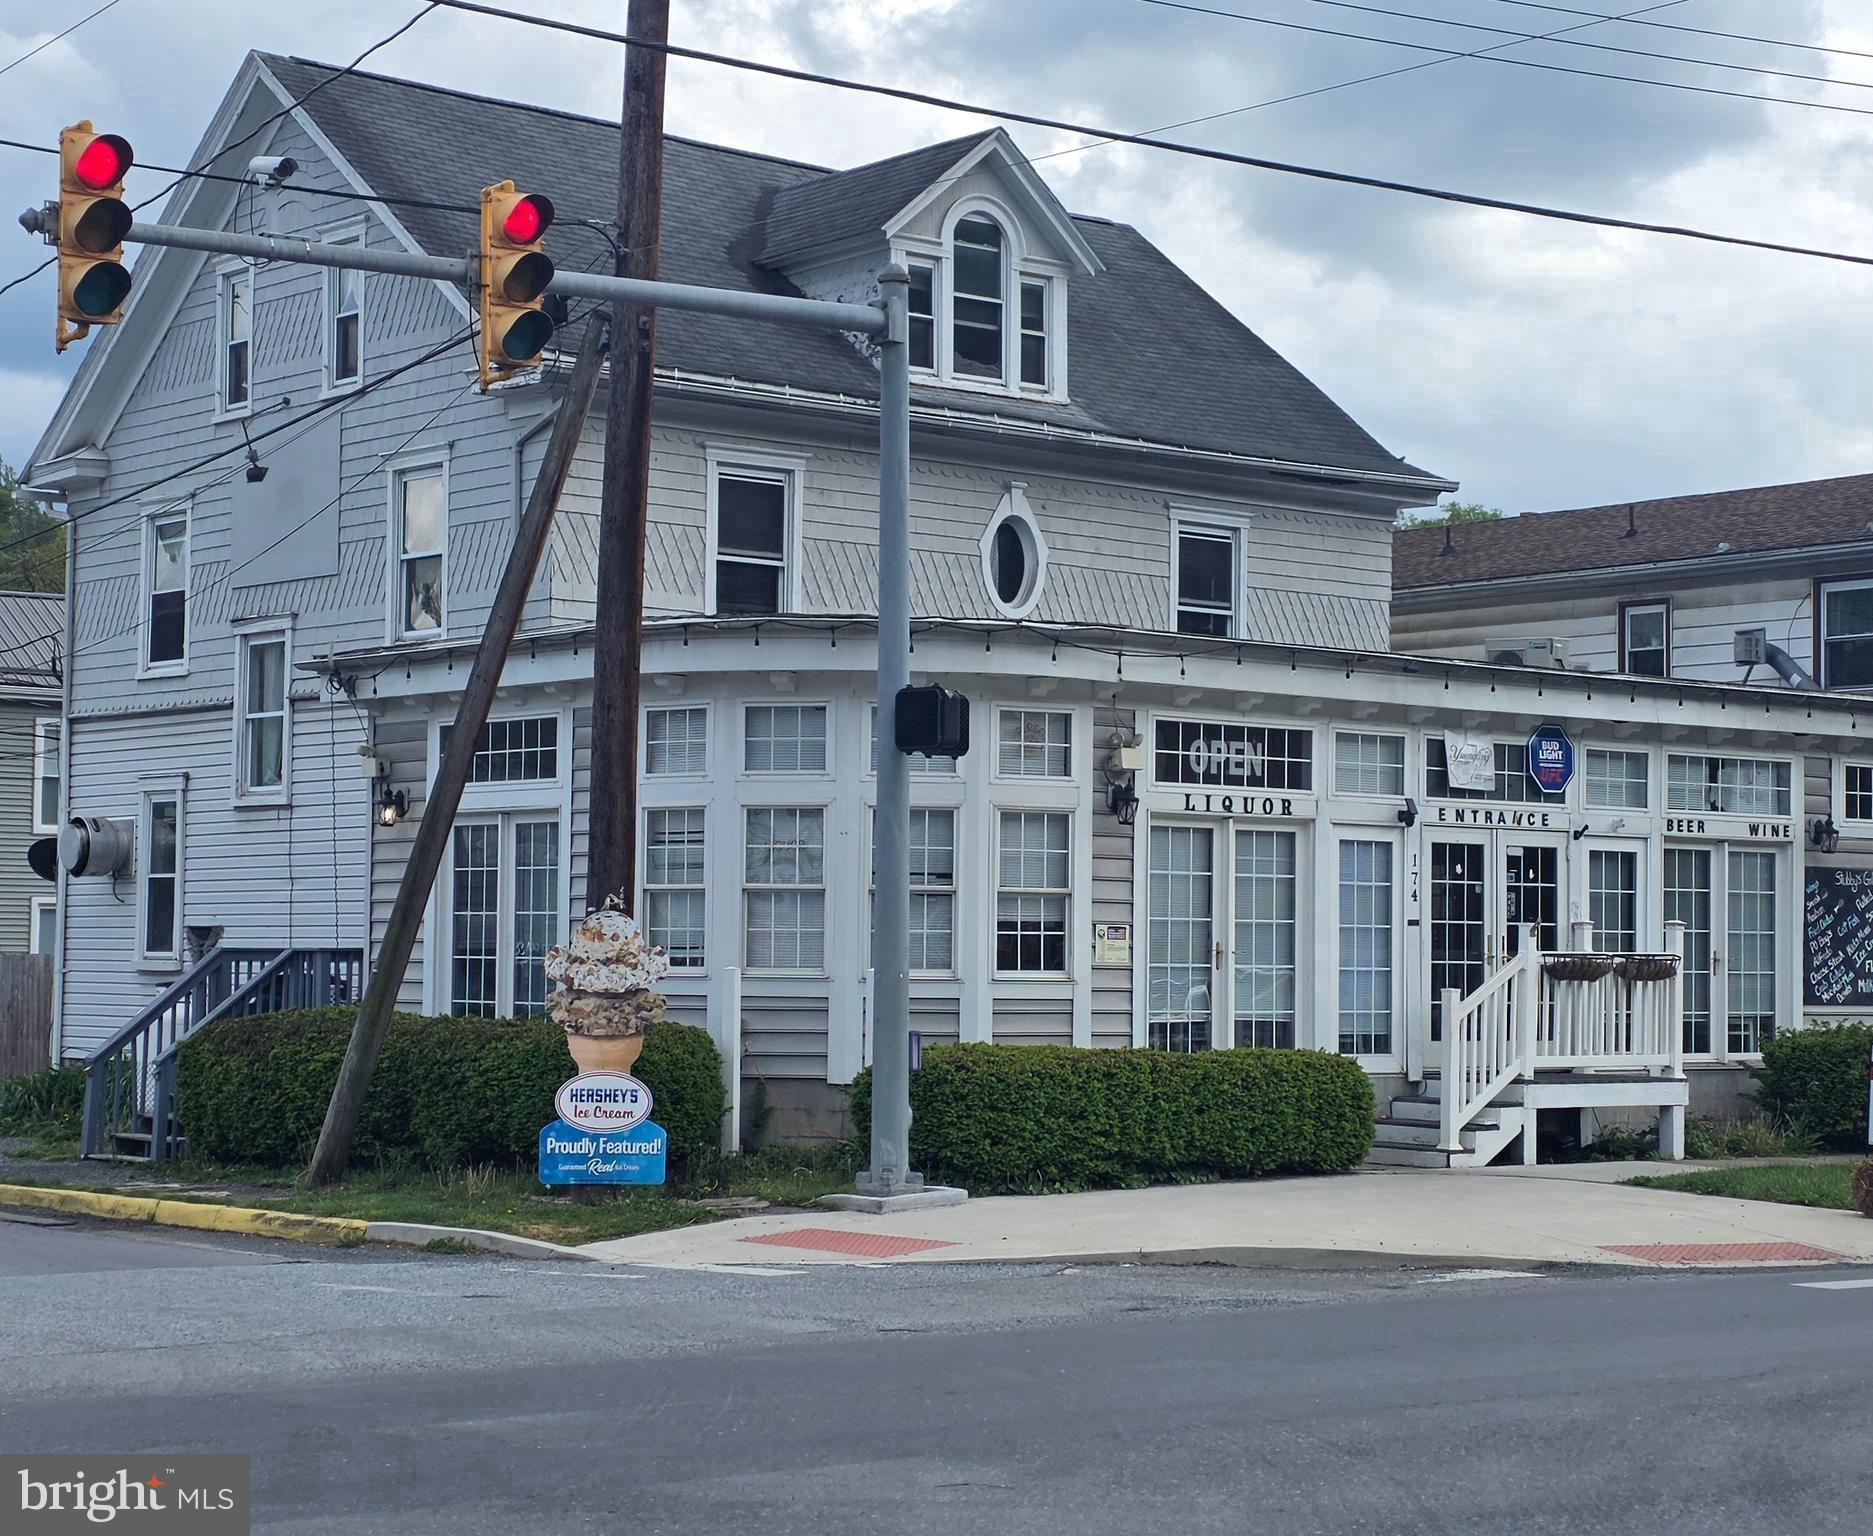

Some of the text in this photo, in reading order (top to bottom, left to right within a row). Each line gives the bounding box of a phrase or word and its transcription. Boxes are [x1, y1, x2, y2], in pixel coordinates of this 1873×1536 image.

[1539, 749, 1563, 760] LIGHT
[1541, 740, 1560, 751] BUD
[1189, 739, 1263, 777] OPEN
[1540, 767, 1564, 782] UFC
[1184, 793, 1293, 816] LIQUOR
[1438, 807, 1549, 827] ENTRANCE
[1666, 819, 1790, 838] BEER WINE
[1411, 853, 1419, 902] 174
[570, 1088, 639, 1104] HERSHEY'S
[574, 1104, 636, 1119] Ice Cream
[546, 1137, 663, 1157] Proudly Featured!
[587, 1158, 617, 1176] Real
